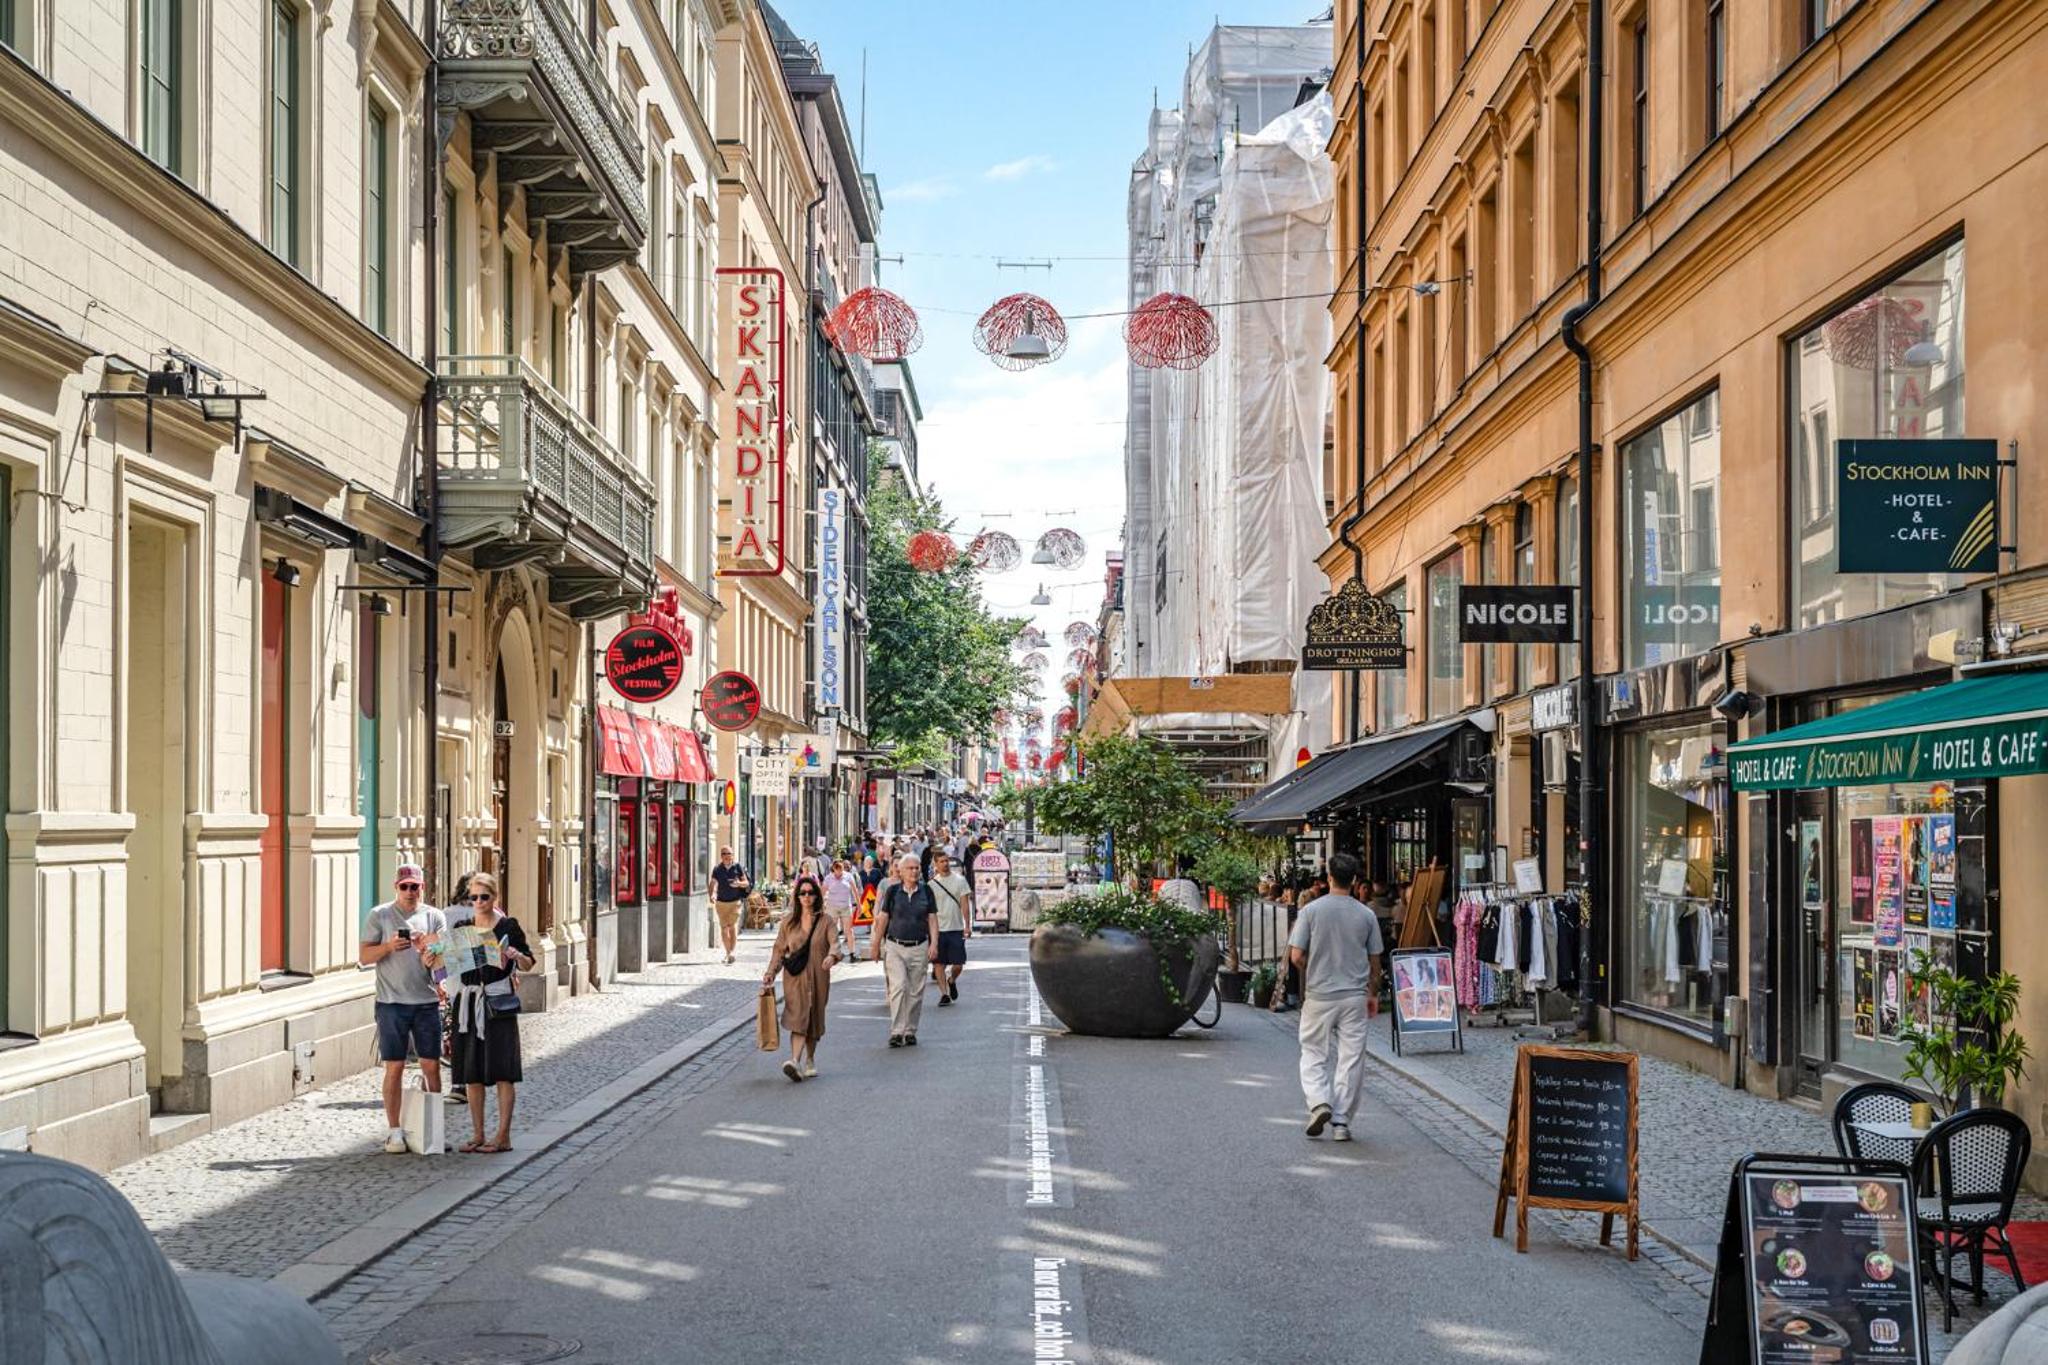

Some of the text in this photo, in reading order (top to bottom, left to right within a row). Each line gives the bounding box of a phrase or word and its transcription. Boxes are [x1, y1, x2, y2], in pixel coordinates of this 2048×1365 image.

[735, 286, 764, 556] SKANDIA
[1912, 510, 1923, 523] &
[1467, 604, 1567, 624] NICOLE
[633, 639, 655, 648] FILM
[1307, 648, 1402, 657] DROTTNINGHOF
[611, 650, 676, 678] Stockholm
[624, 680, 662, 688] FESTIVAL
[497, 723, 511, 733] 82
[1736, 760, 1761, 783] HOTEL
[1763, 758, 1770, 781] &
[1772, 756, 1796, 781] CAFE
[1933, 738, 1976, 770] HOTEL
[1982, 736, 1992, 766] &
[1998, 731, 2038, 765] CAFE
[756, 759, 784, 768] CITY
